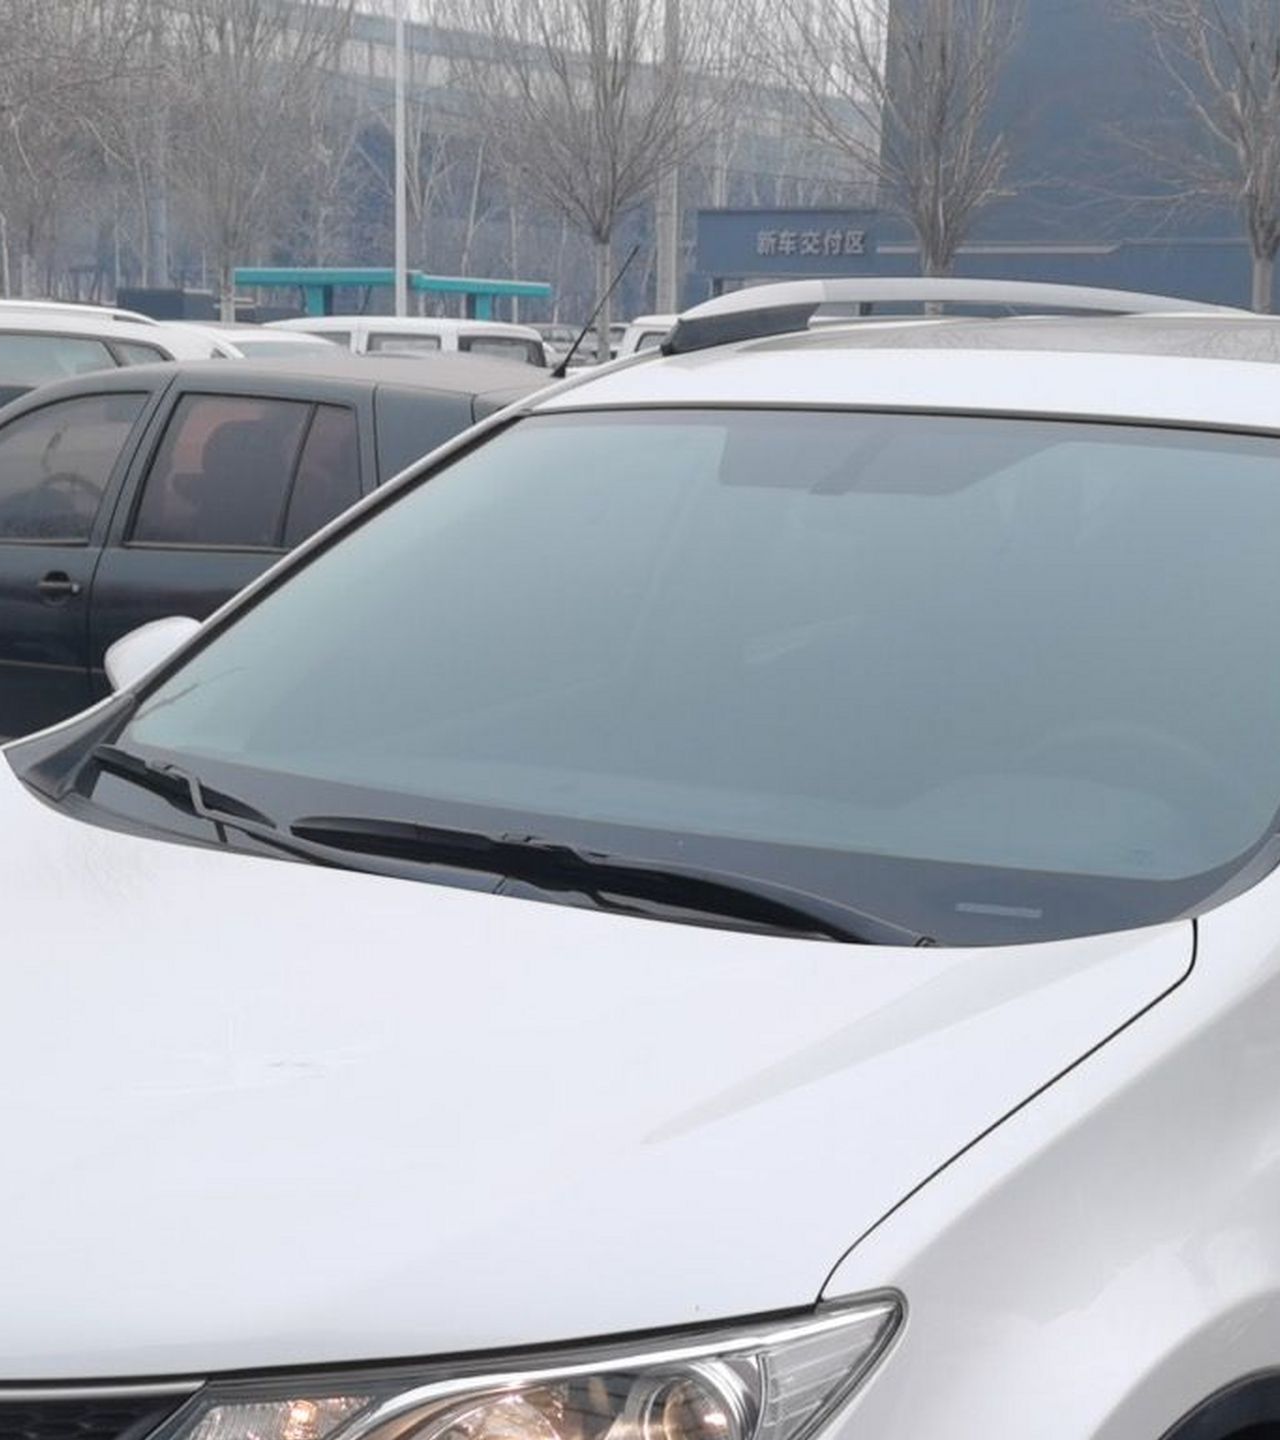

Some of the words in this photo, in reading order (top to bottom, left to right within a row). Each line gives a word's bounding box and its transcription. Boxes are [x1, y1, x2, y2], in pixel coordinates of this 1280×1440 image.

[757, 229, 865, 255] 新车交付区
